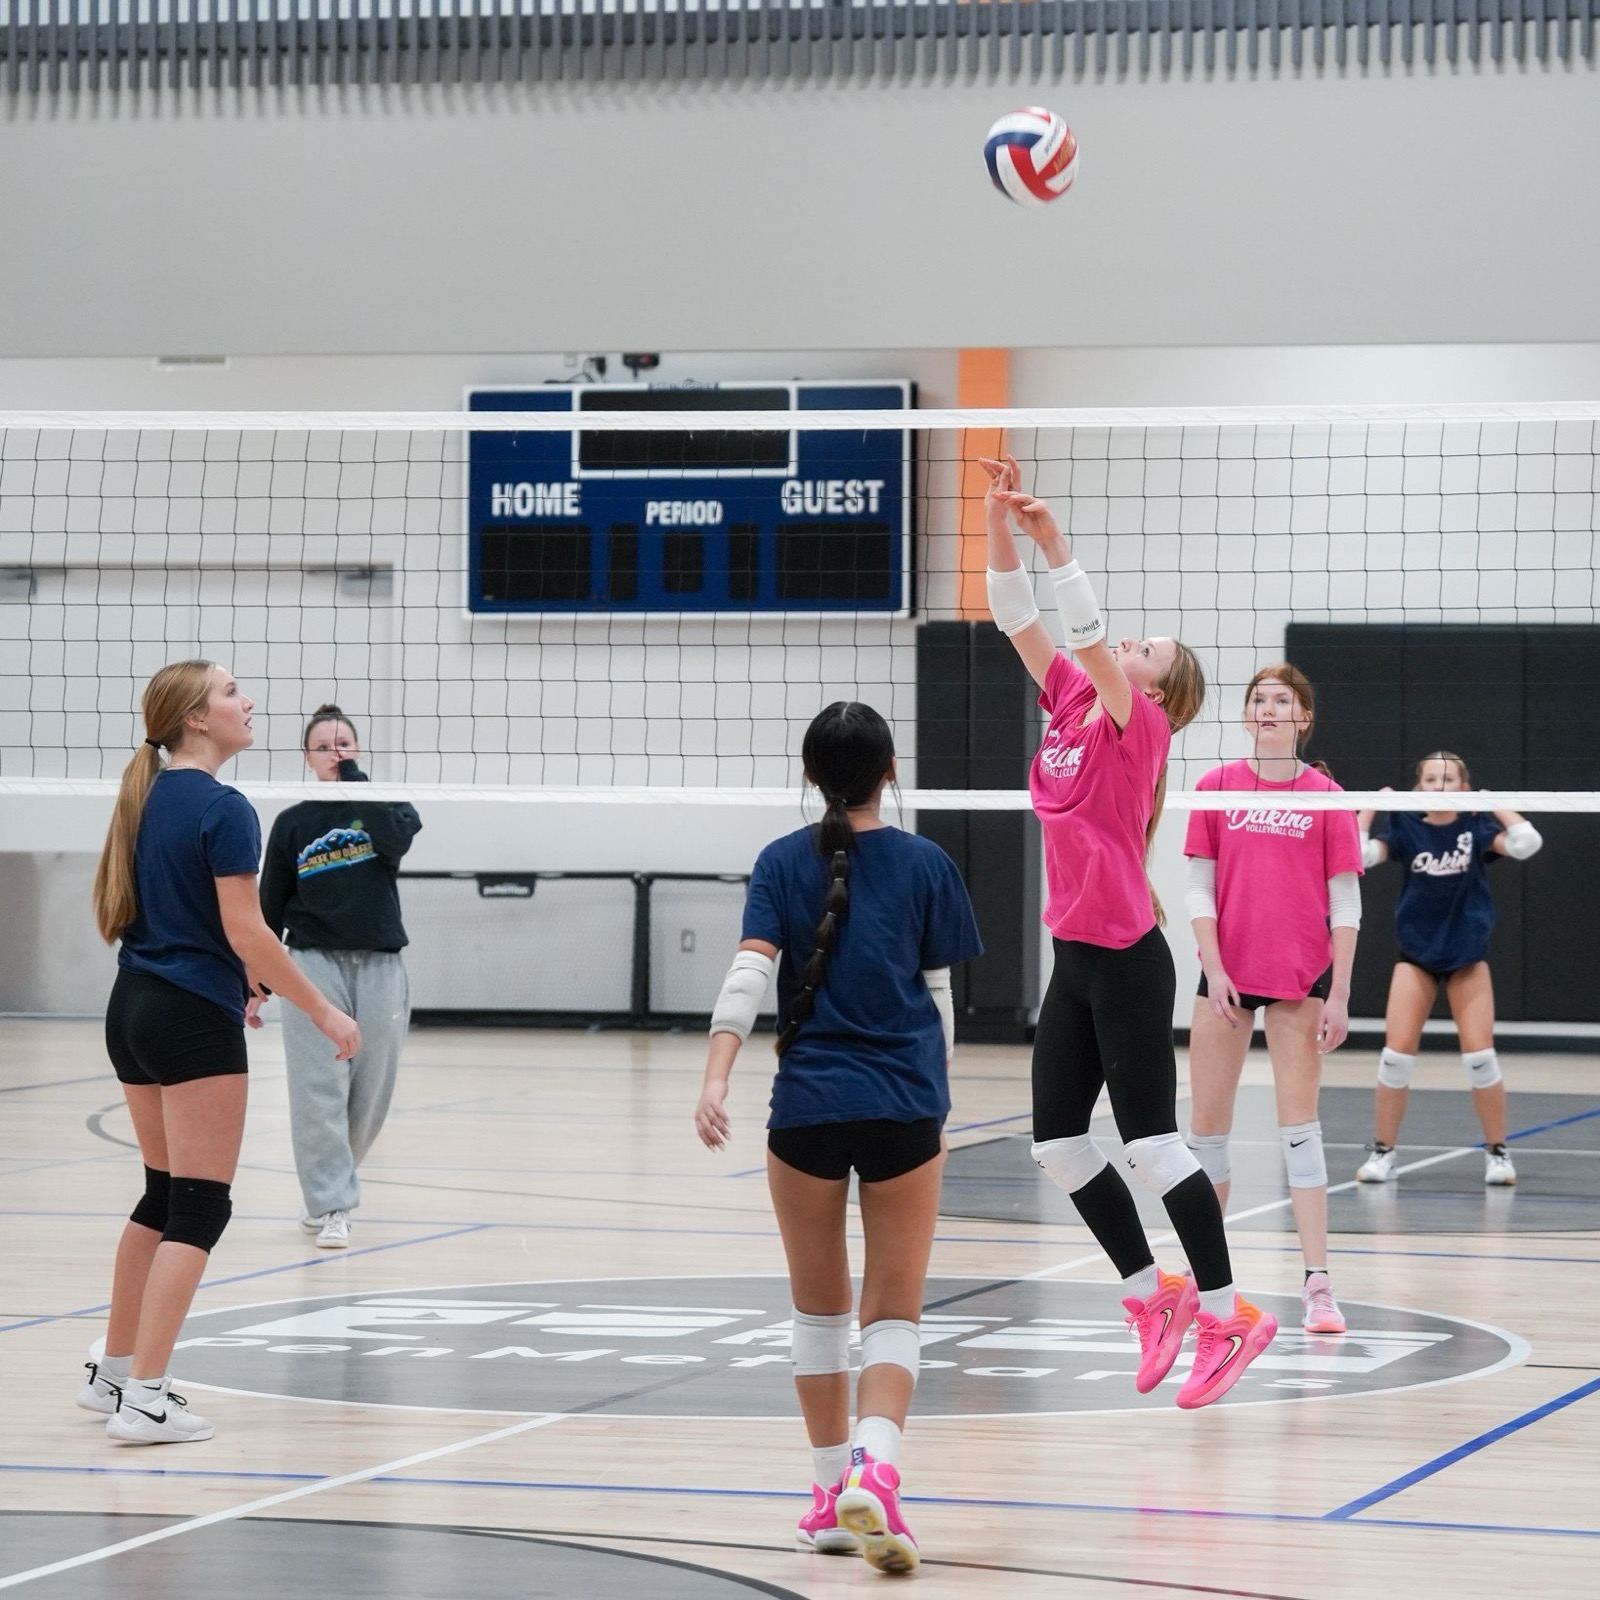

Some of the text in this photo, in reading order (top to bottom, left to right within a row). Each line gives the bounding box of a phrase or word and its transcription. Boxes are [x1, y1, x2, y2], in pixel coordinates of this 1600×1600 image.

[491, 482, 582, 517] HOME
[781, 479, 885, 514] GUEST
[645, 501, 723, 526] PERIOD
[1225, 809, 1313, 831] Dakine
[1245, 823, 1305, 839] VOLLEYBALL CLUB
